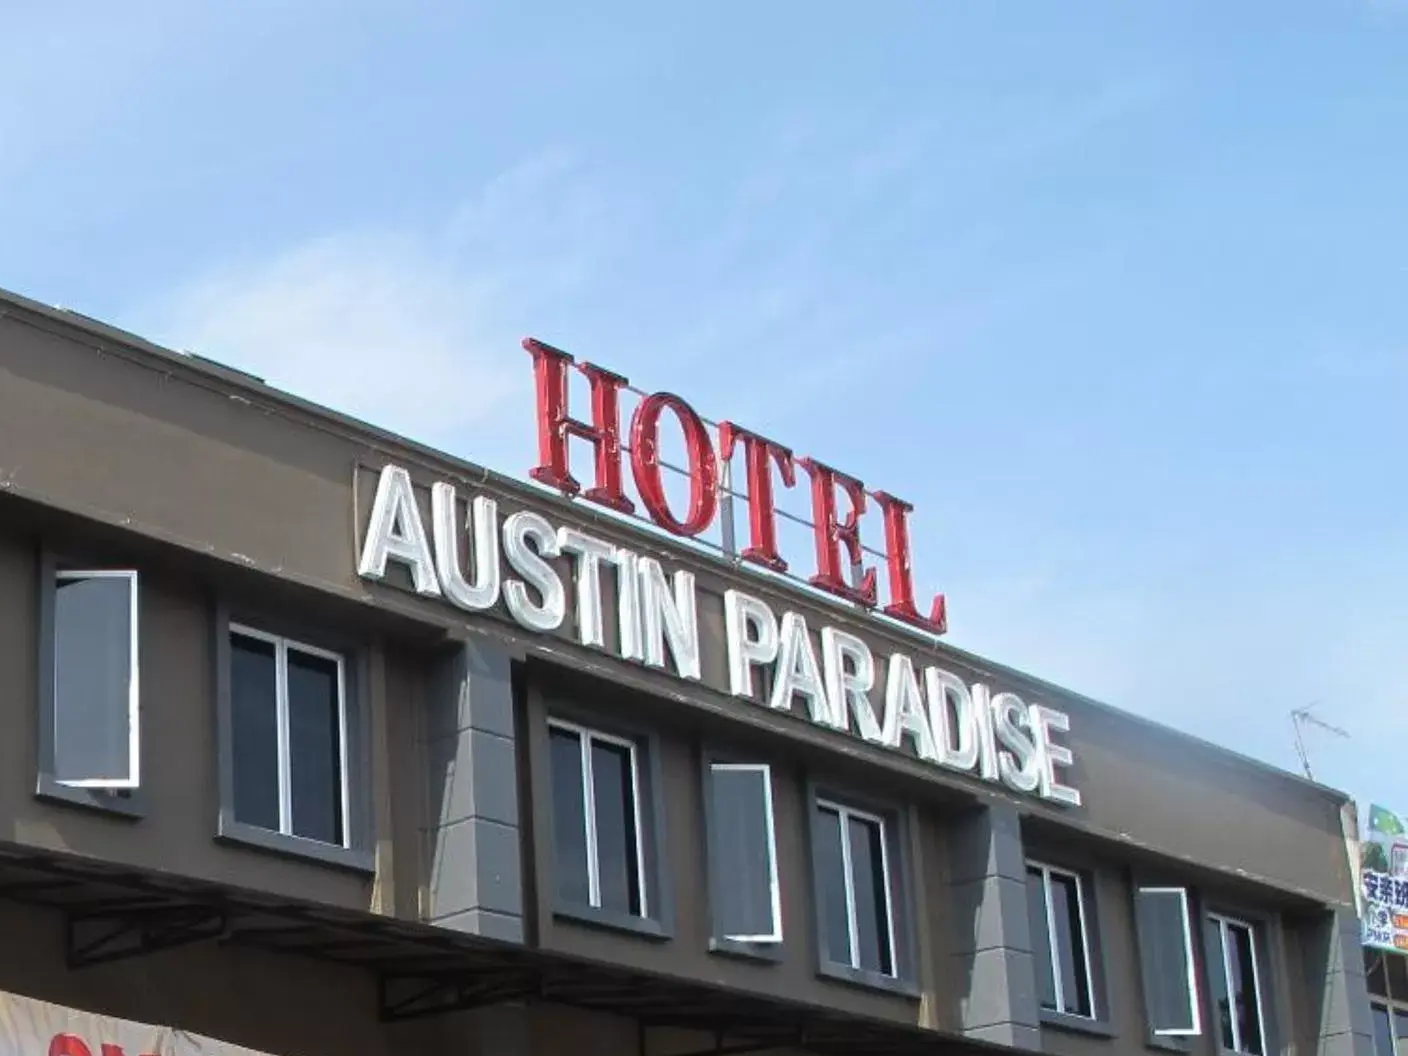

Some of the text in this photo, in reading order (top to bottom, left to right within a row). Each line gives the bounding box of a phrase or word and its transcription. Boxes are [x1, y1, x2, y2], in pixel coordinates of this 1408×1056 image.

[356, 463, 1081, 806] AUSTIN PARADISE
[521, 337, 947, 634] HOTEL
